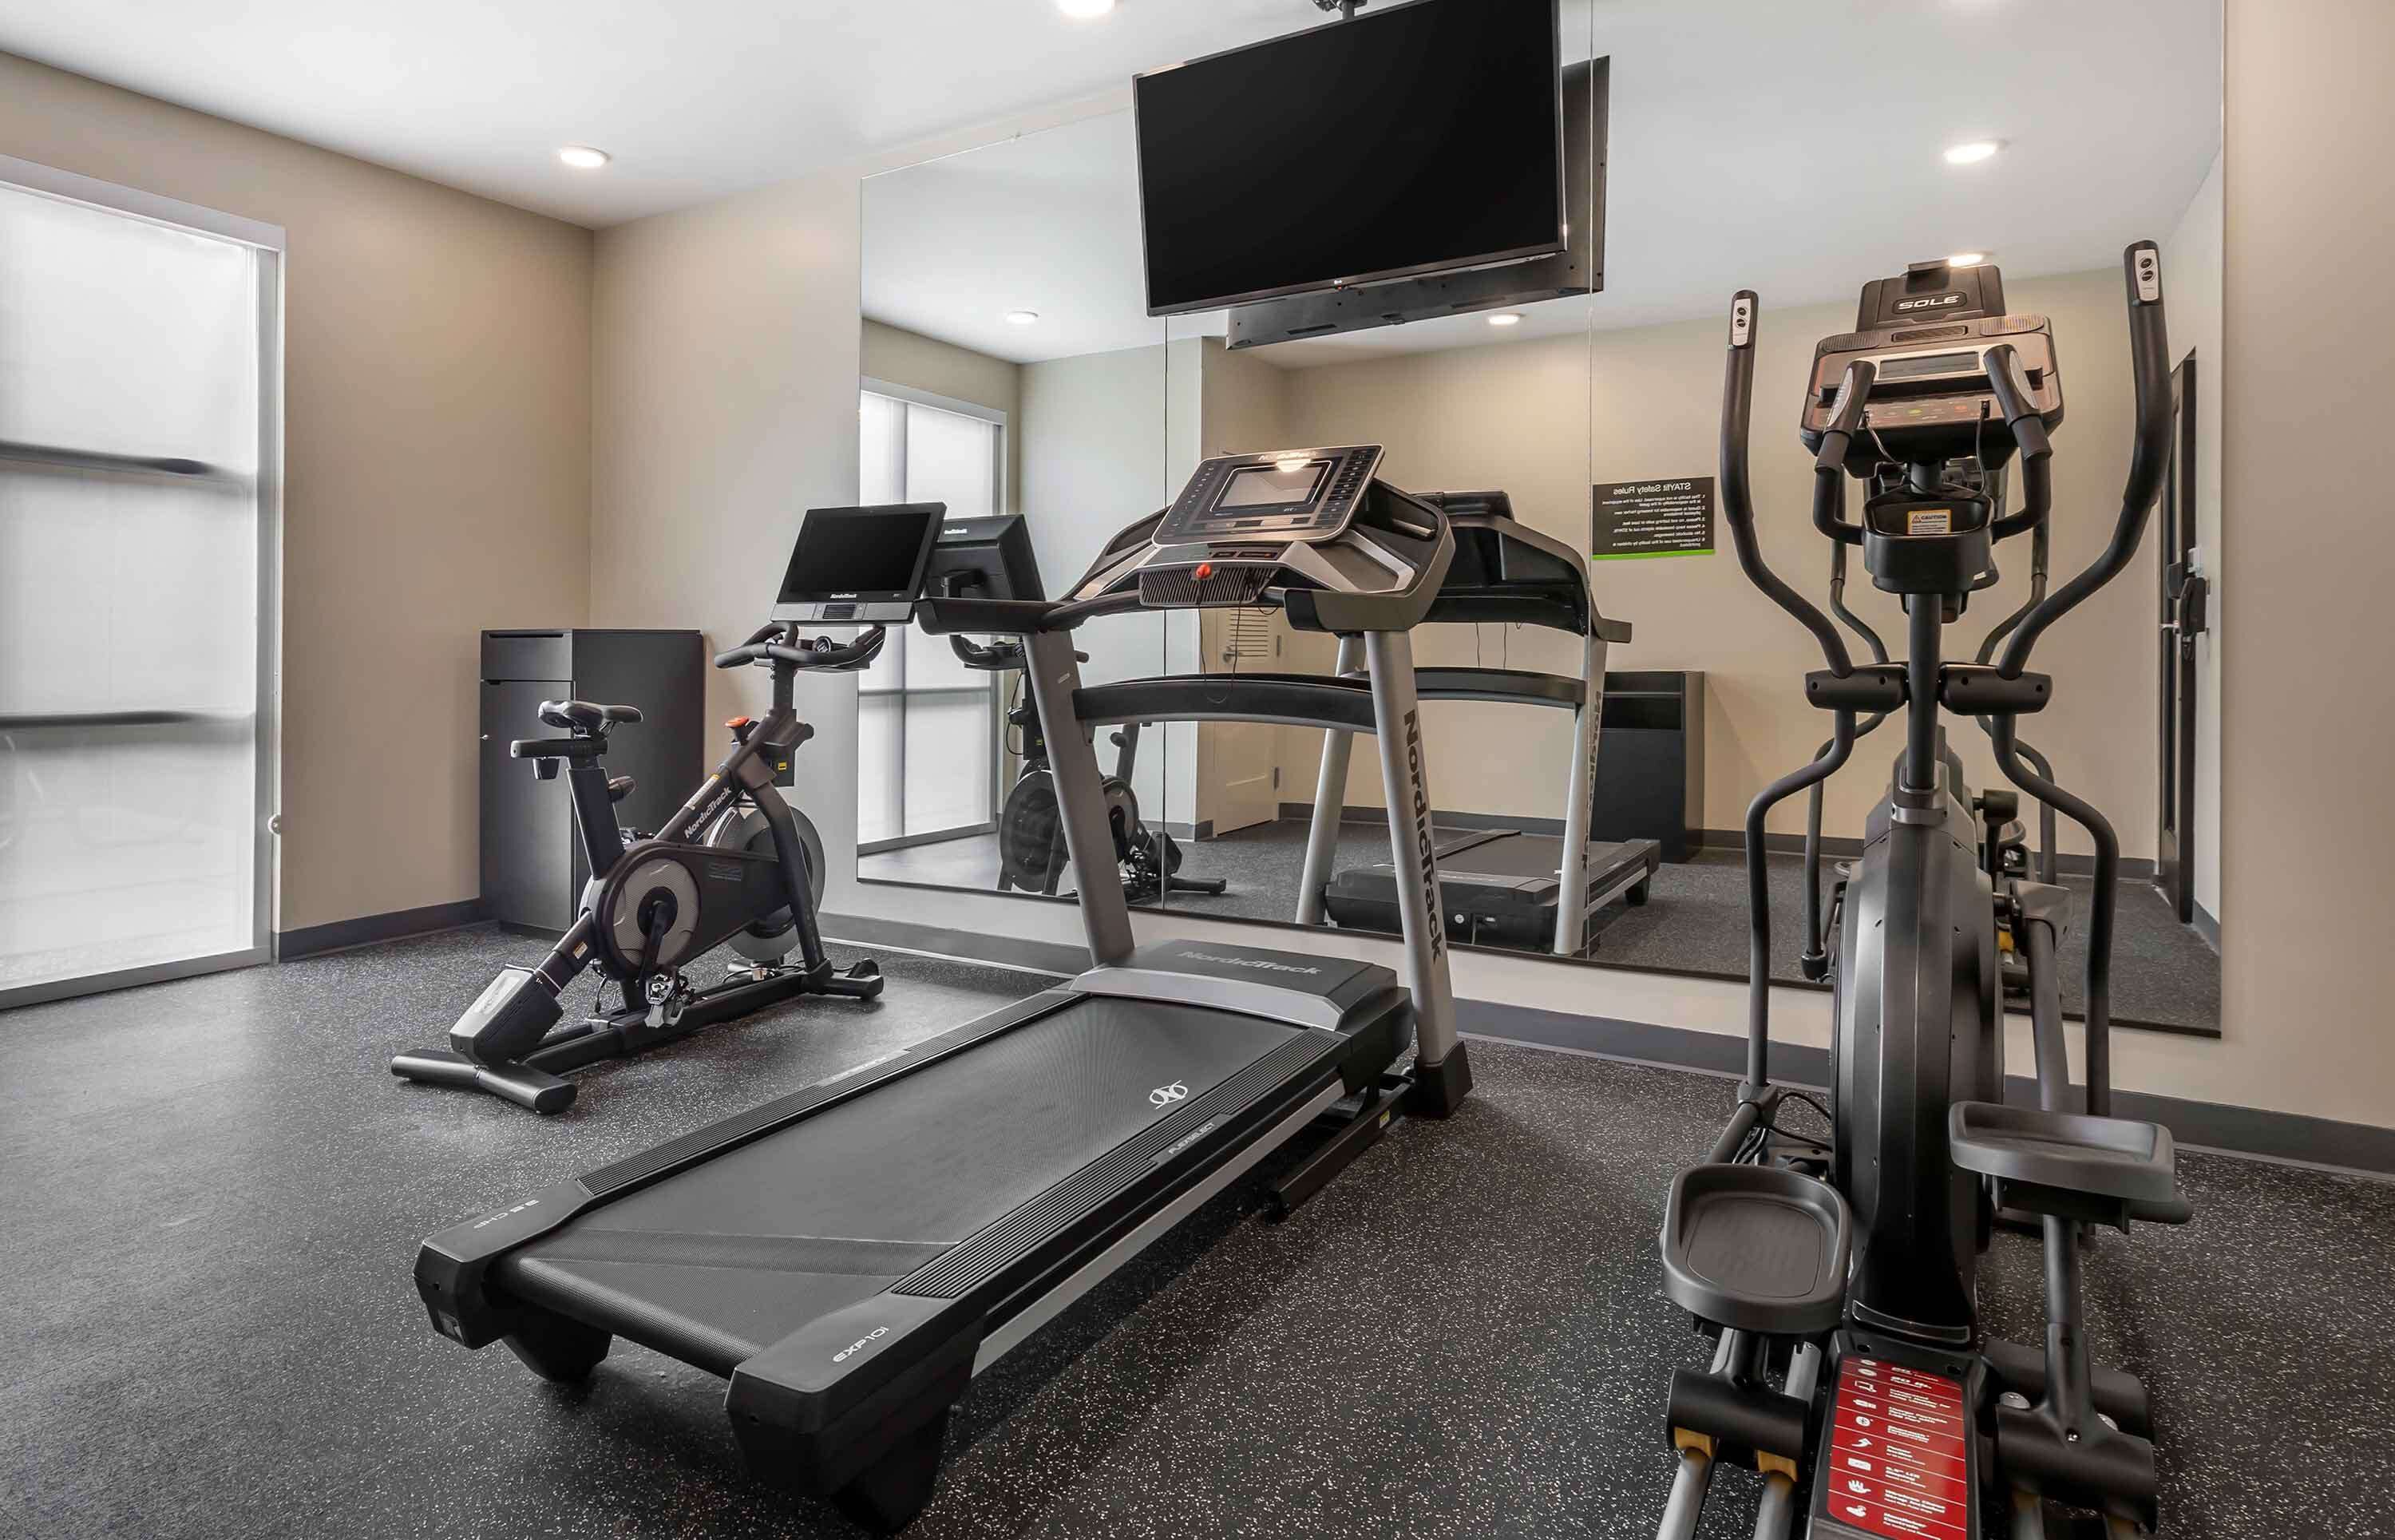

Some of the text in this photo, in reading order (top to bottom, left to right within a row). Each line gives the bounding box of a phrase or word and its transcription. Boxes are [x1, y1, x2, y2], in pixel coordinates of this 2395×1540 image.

[1898, 295, 1960, 310] SOLE
[683, 786, 732, 839] NordicTrack
[1403, 708, 1445, 964] NordicTrack
[1174, 951, 1323, 975] NordicTrack
